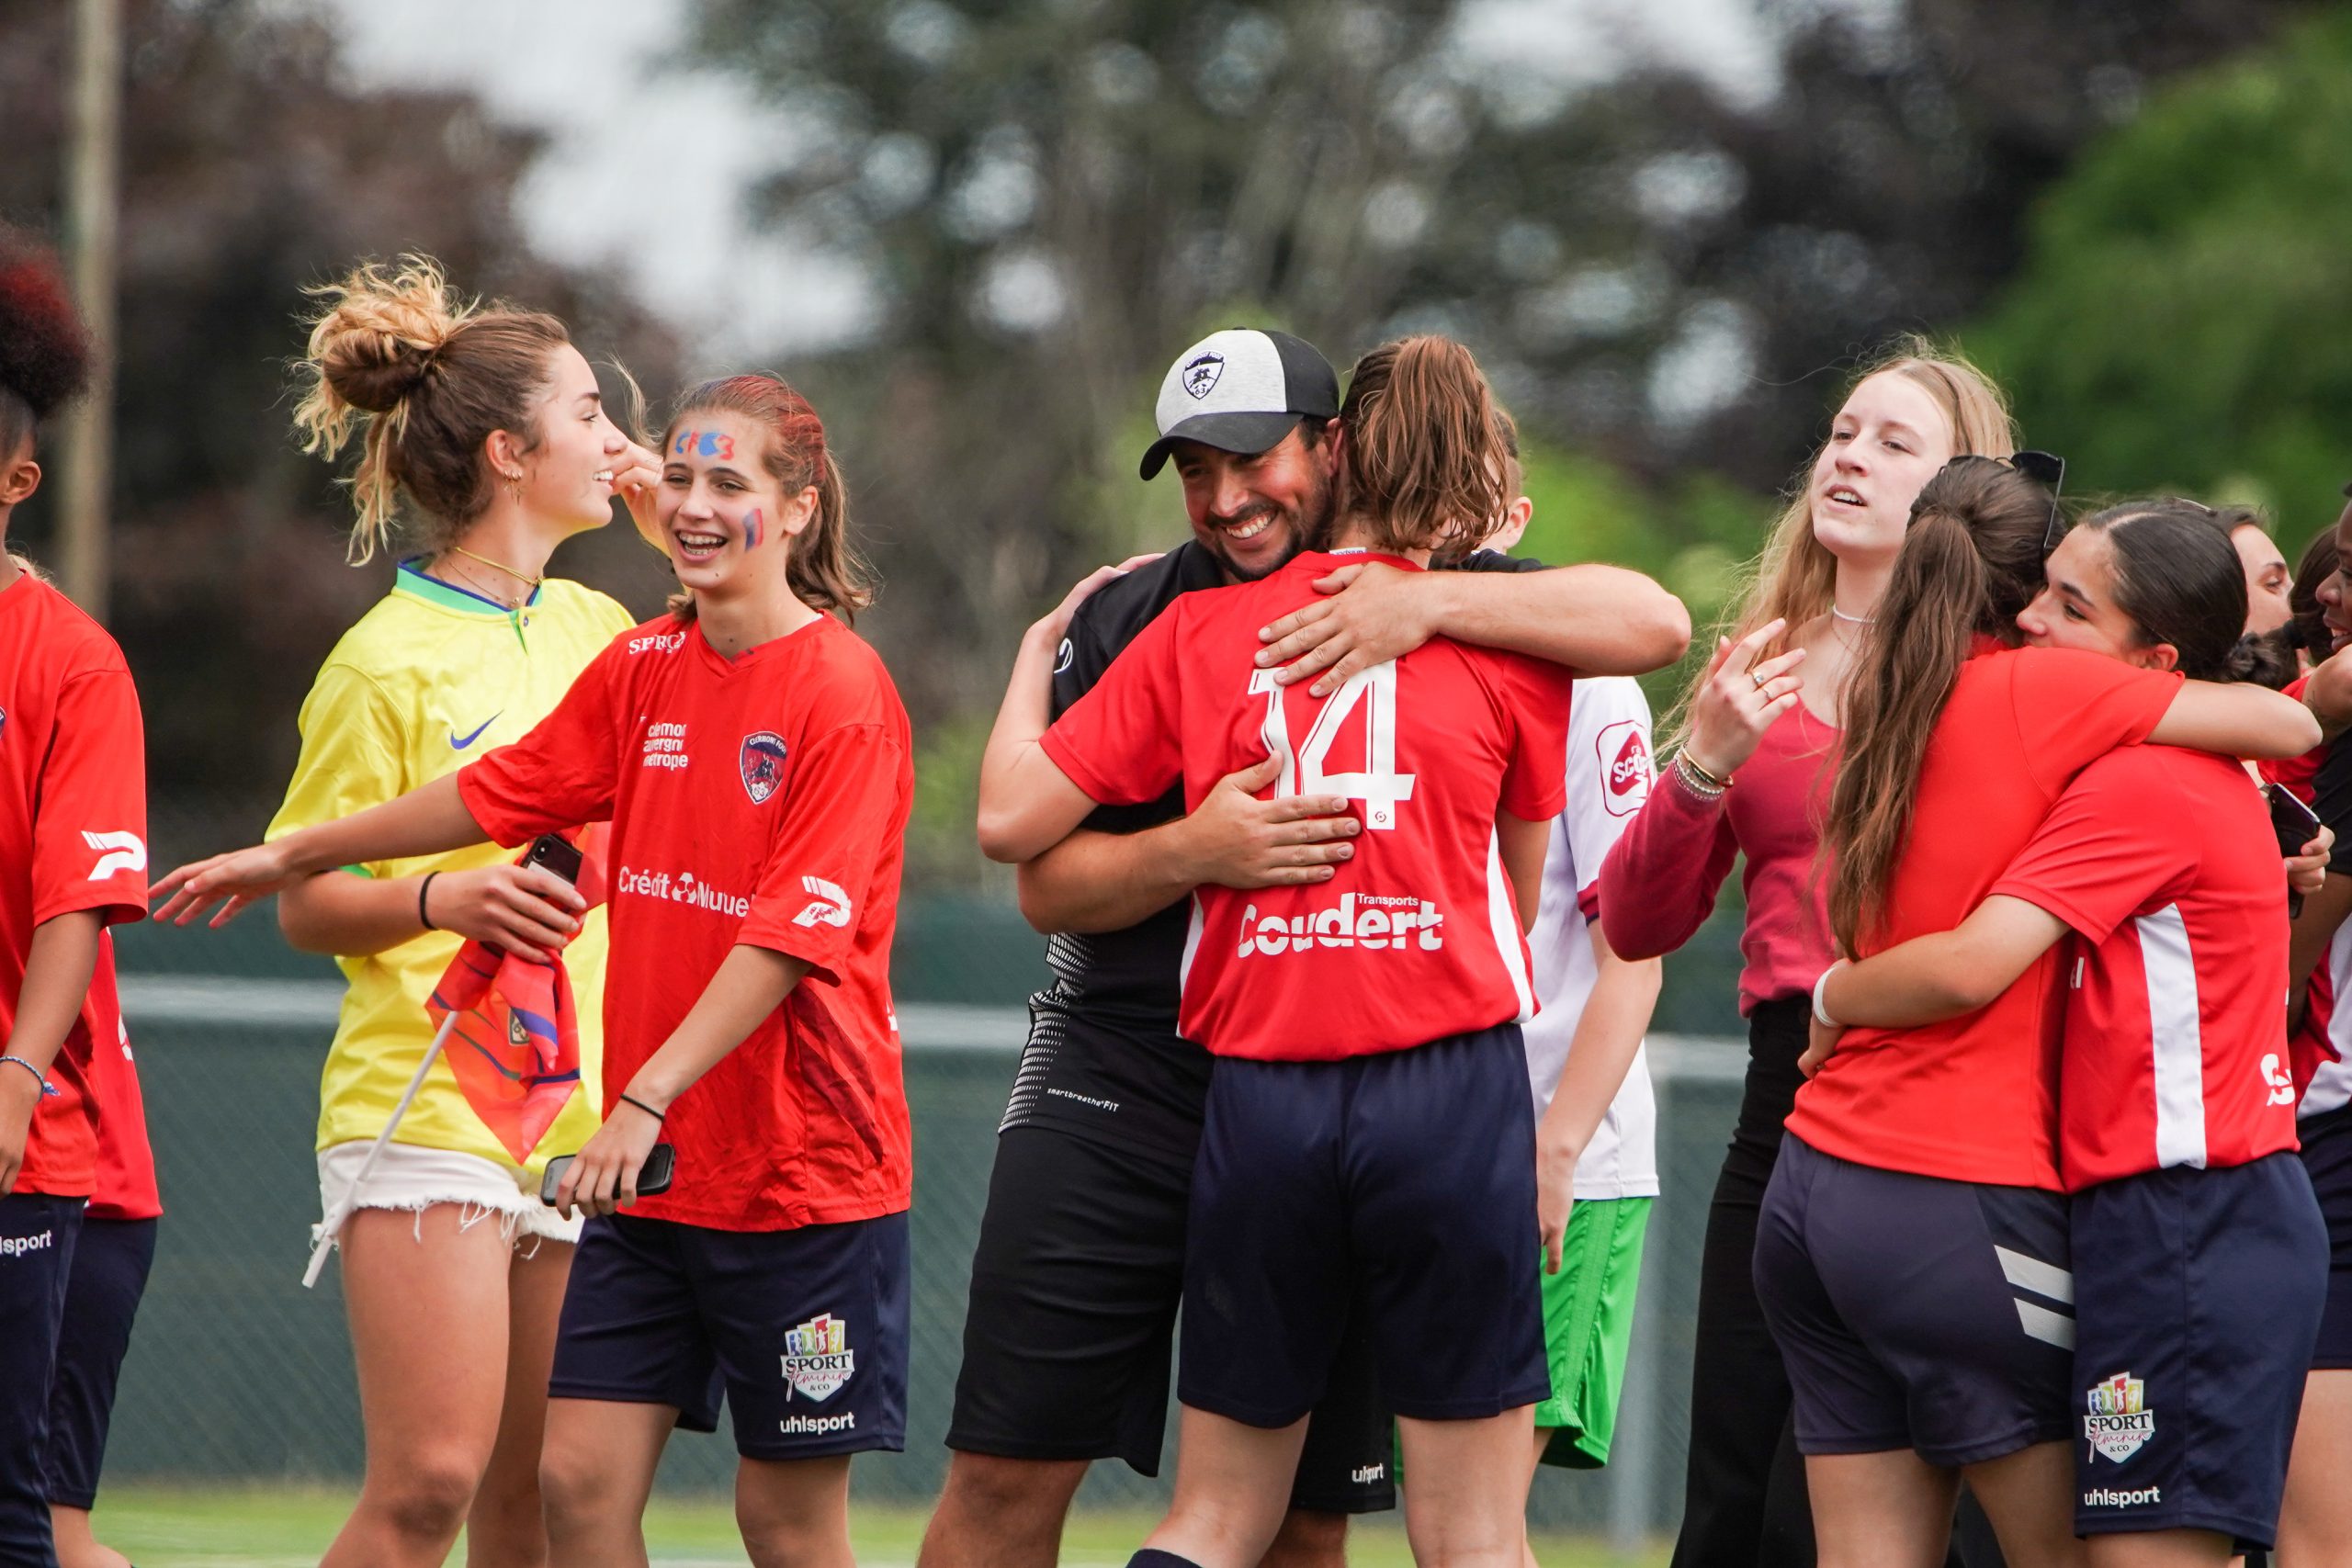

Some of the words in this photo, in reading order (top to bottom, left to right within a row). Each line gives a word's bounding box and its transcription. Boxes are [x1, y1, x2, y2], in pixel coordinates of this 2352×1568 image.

[1248, 659, 1416, 830] 14
[1357, 893, 1419, 908] Transports
[1238, 892, 1444, 958] Coudert
[786, 1354, 850, 1374] SPORT
[817, 1382, 831, 1392] CO
[779, 1411, 855, 1436] uhlsport
[2088, 1414, 2150, 1434] SPORT
[2117, 1444, 2130, 1452] CO
[2084, 1484, 2161, 1509] uhlsport
